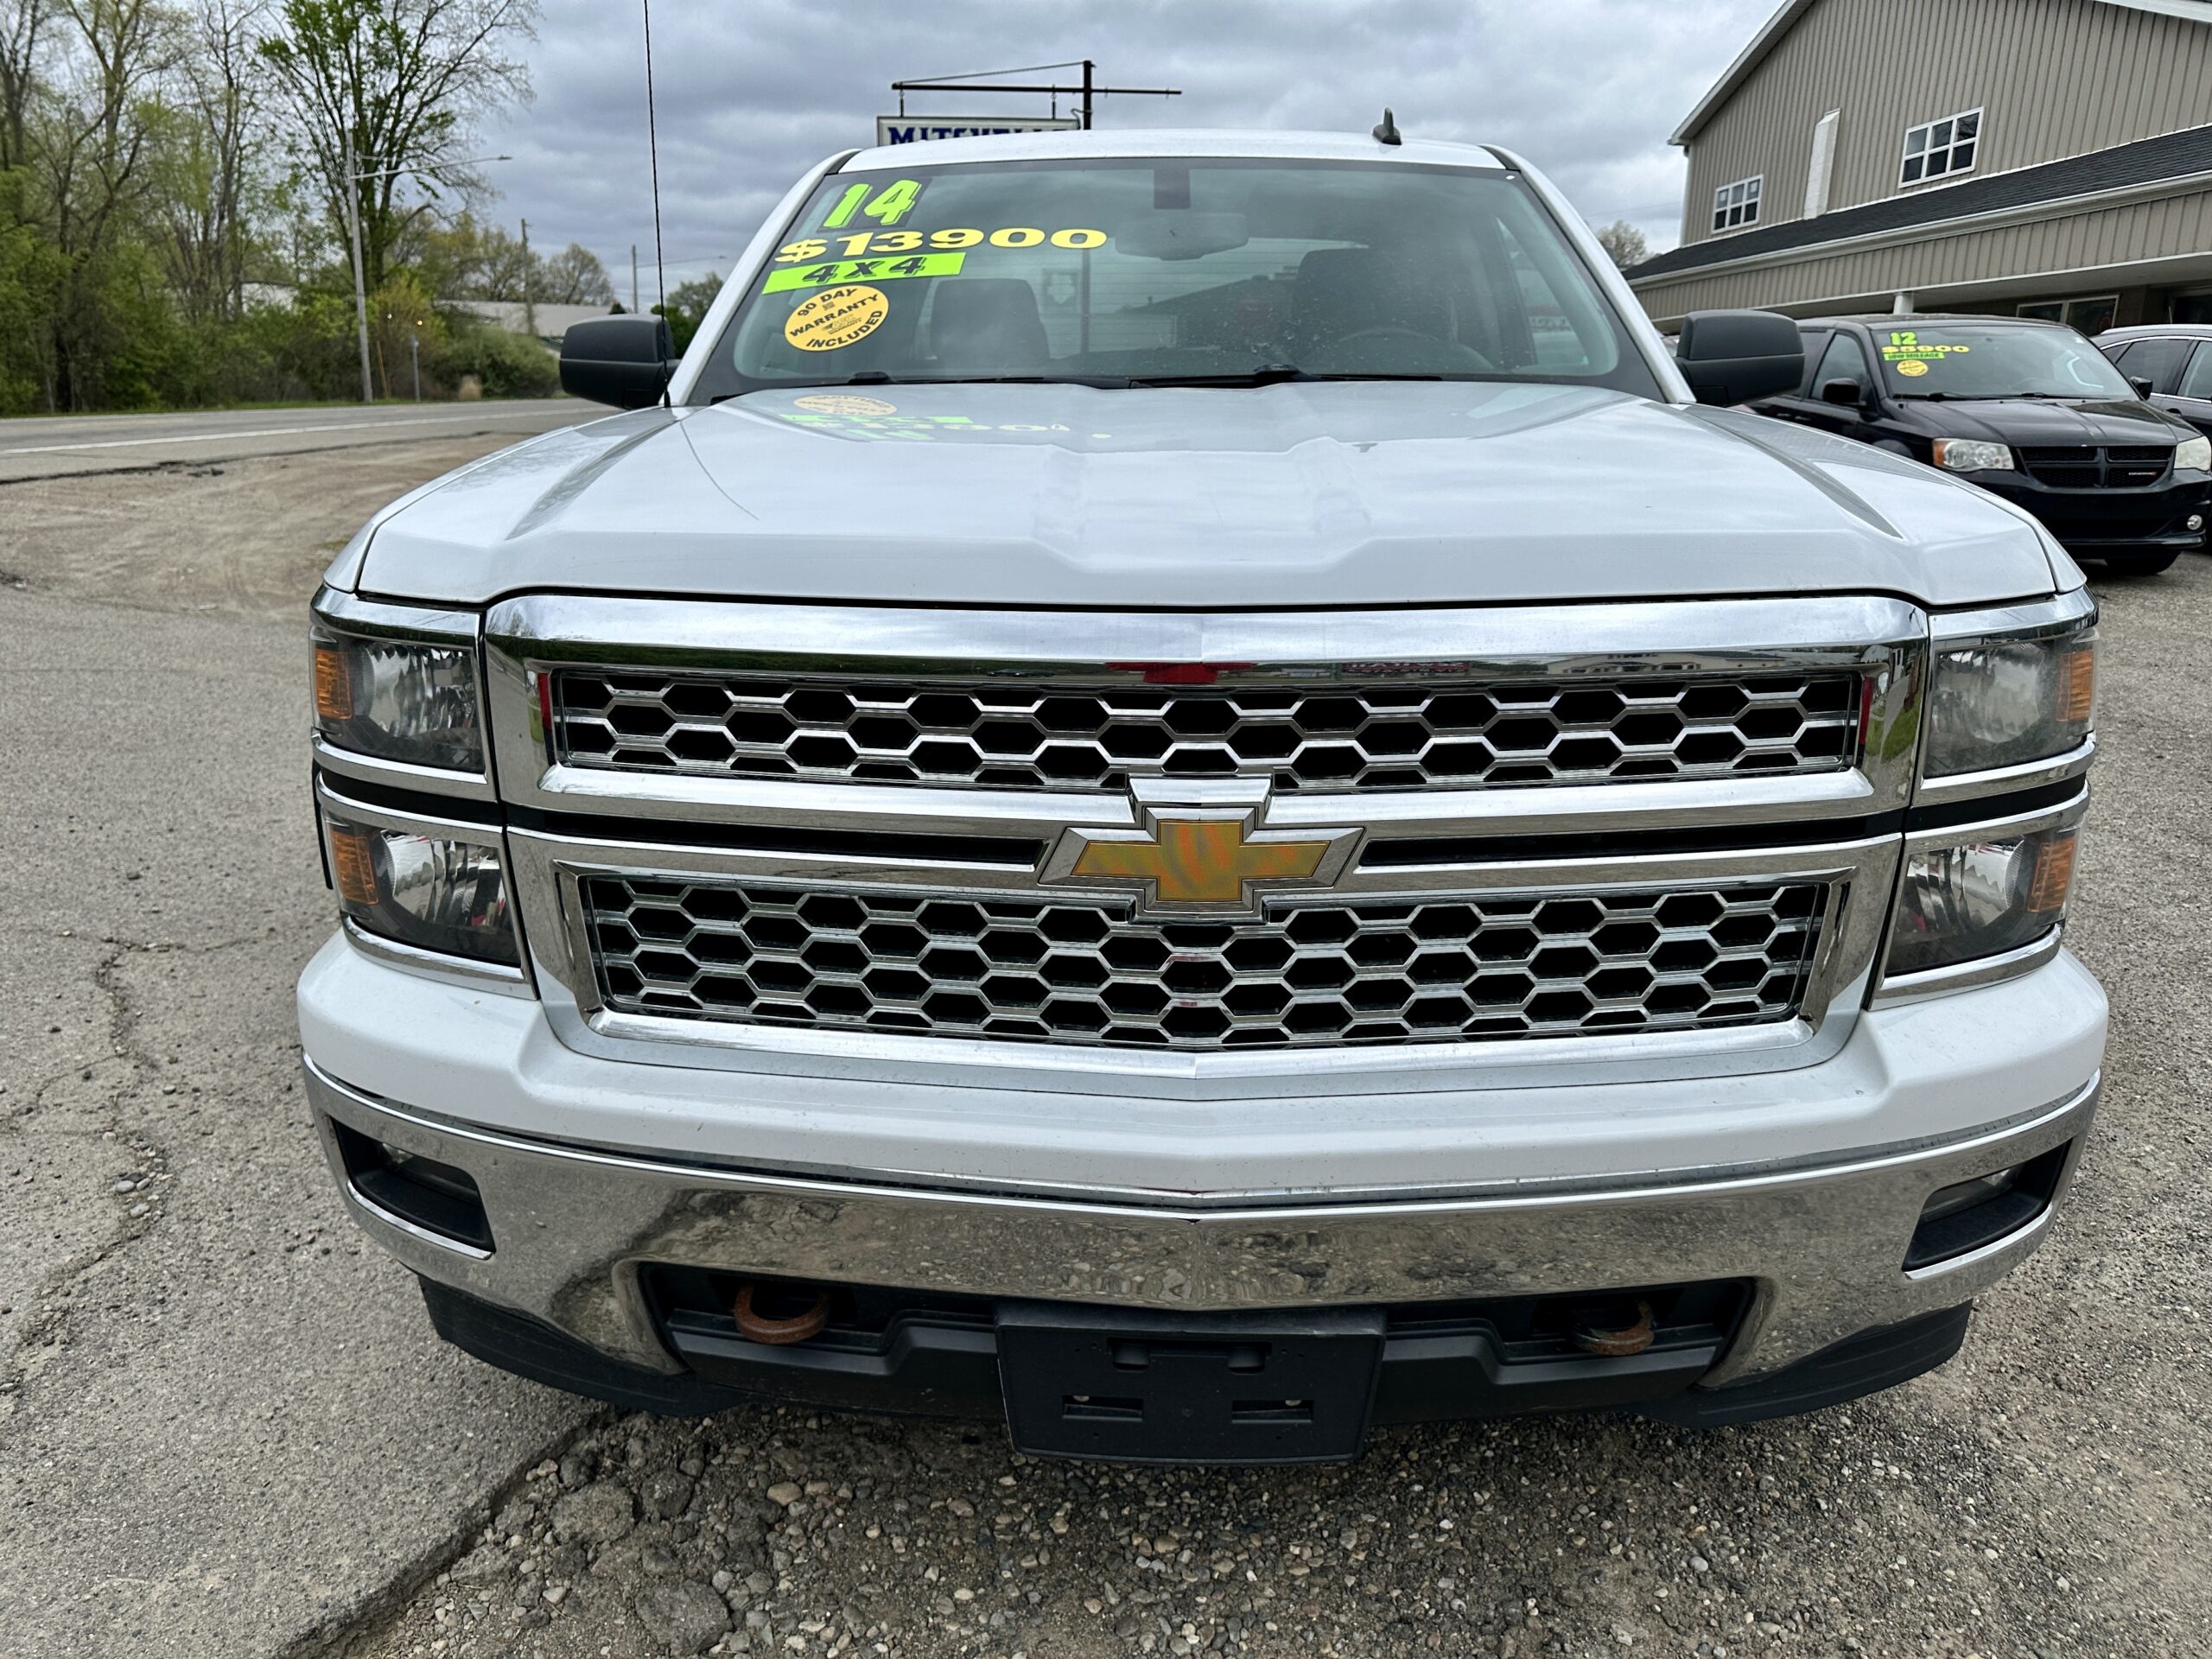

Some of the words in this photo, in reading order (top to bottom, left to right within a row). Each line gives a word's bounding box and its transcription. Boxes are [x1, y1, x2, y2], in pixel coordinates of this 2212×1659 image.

[823, 179, 923, 227] 14
[775, 227, 1108, 263] $13900
[790, 294, 878, 337] WARRANTY
[797, 302, 817, 316] 90
[820, 289, 857, 302] DAY
[806, 310, 883, 347] INCLUDED
[1890, 331, 1917, 346] 12
